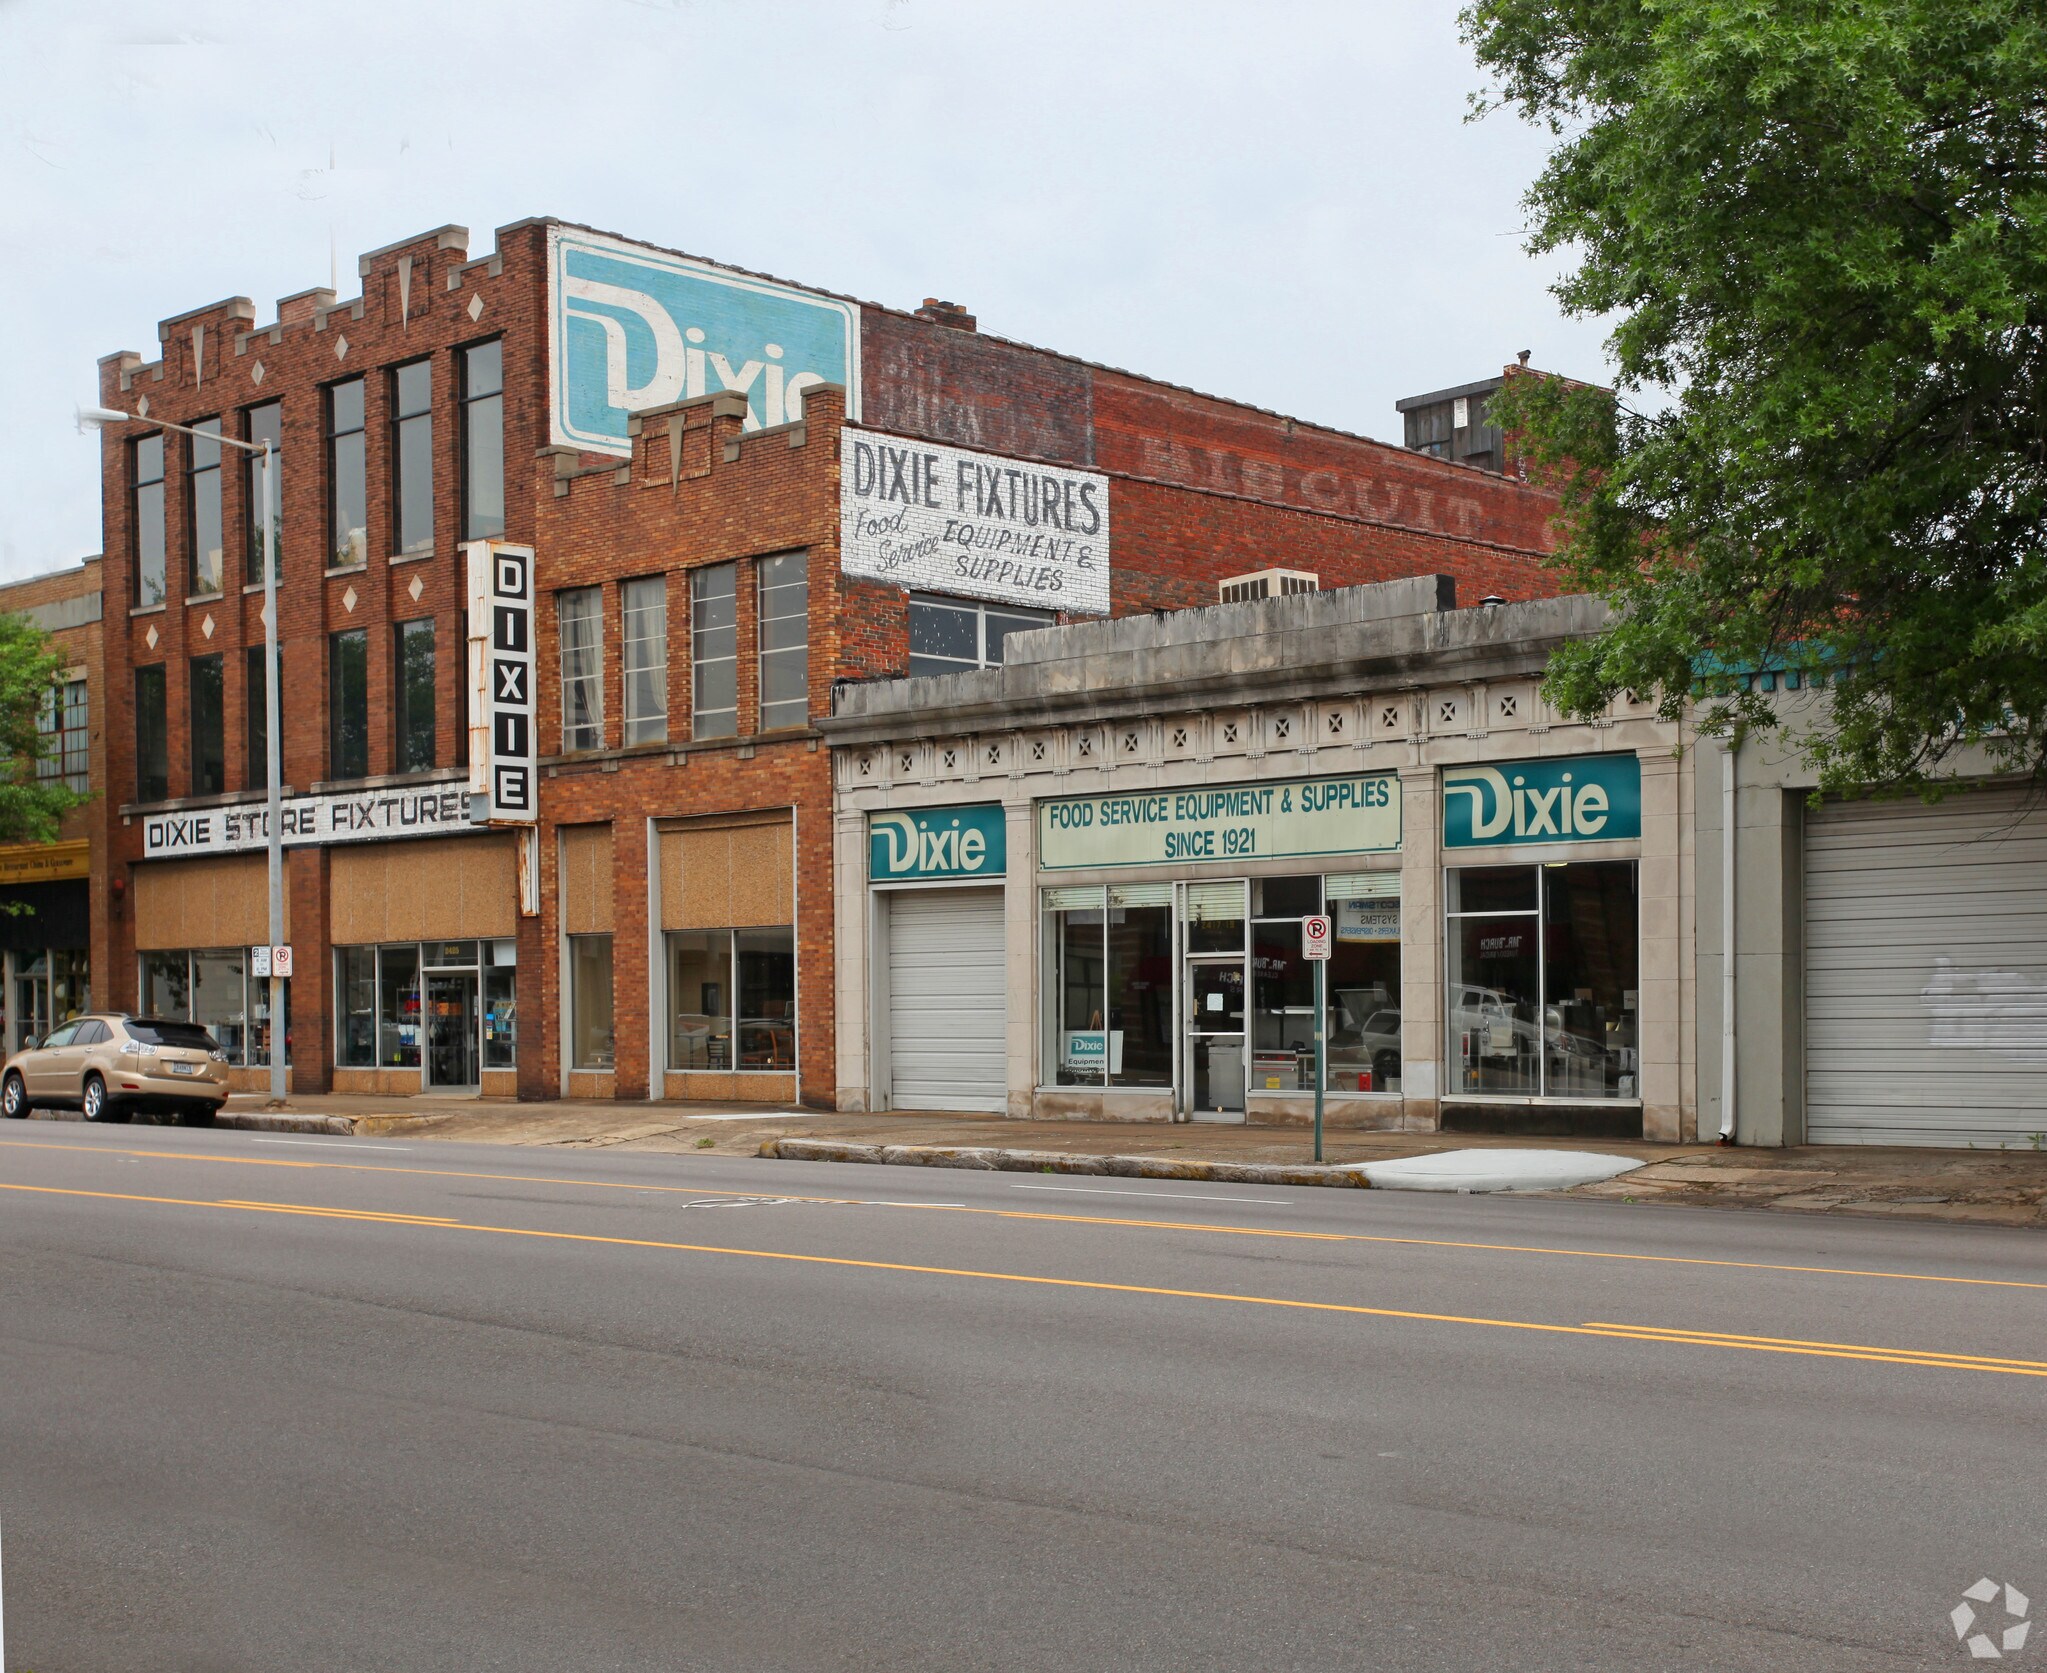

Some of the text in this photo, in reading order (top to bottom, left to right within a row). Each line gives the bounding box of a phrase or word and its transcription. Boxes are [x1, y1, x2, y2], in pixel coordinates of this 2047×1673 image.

[854, 440, 1101, 536] DIXIE FIXTURES
[854, 506, 909, 541] Food
[942, 519, 1098, 572] EQUIPMENT &
[876, 532, 939, 573] Service
[954, 554, 1064, 592] SUPPLIES
[497, 558, 524, 805] DIXIE
[1050, 779, 1389, 829] FOOD SERVICE EQUIPMENT & SUPPLIES
[1445, 767, 1609, 839] Dixie
[149, 817, 211, 848] DIXIE
[871, 813, 986, 872] Dixie
[1165, 827, 1256, 859] SINCE 1921
[1072, 1038, 1103, 1051] Dixie
